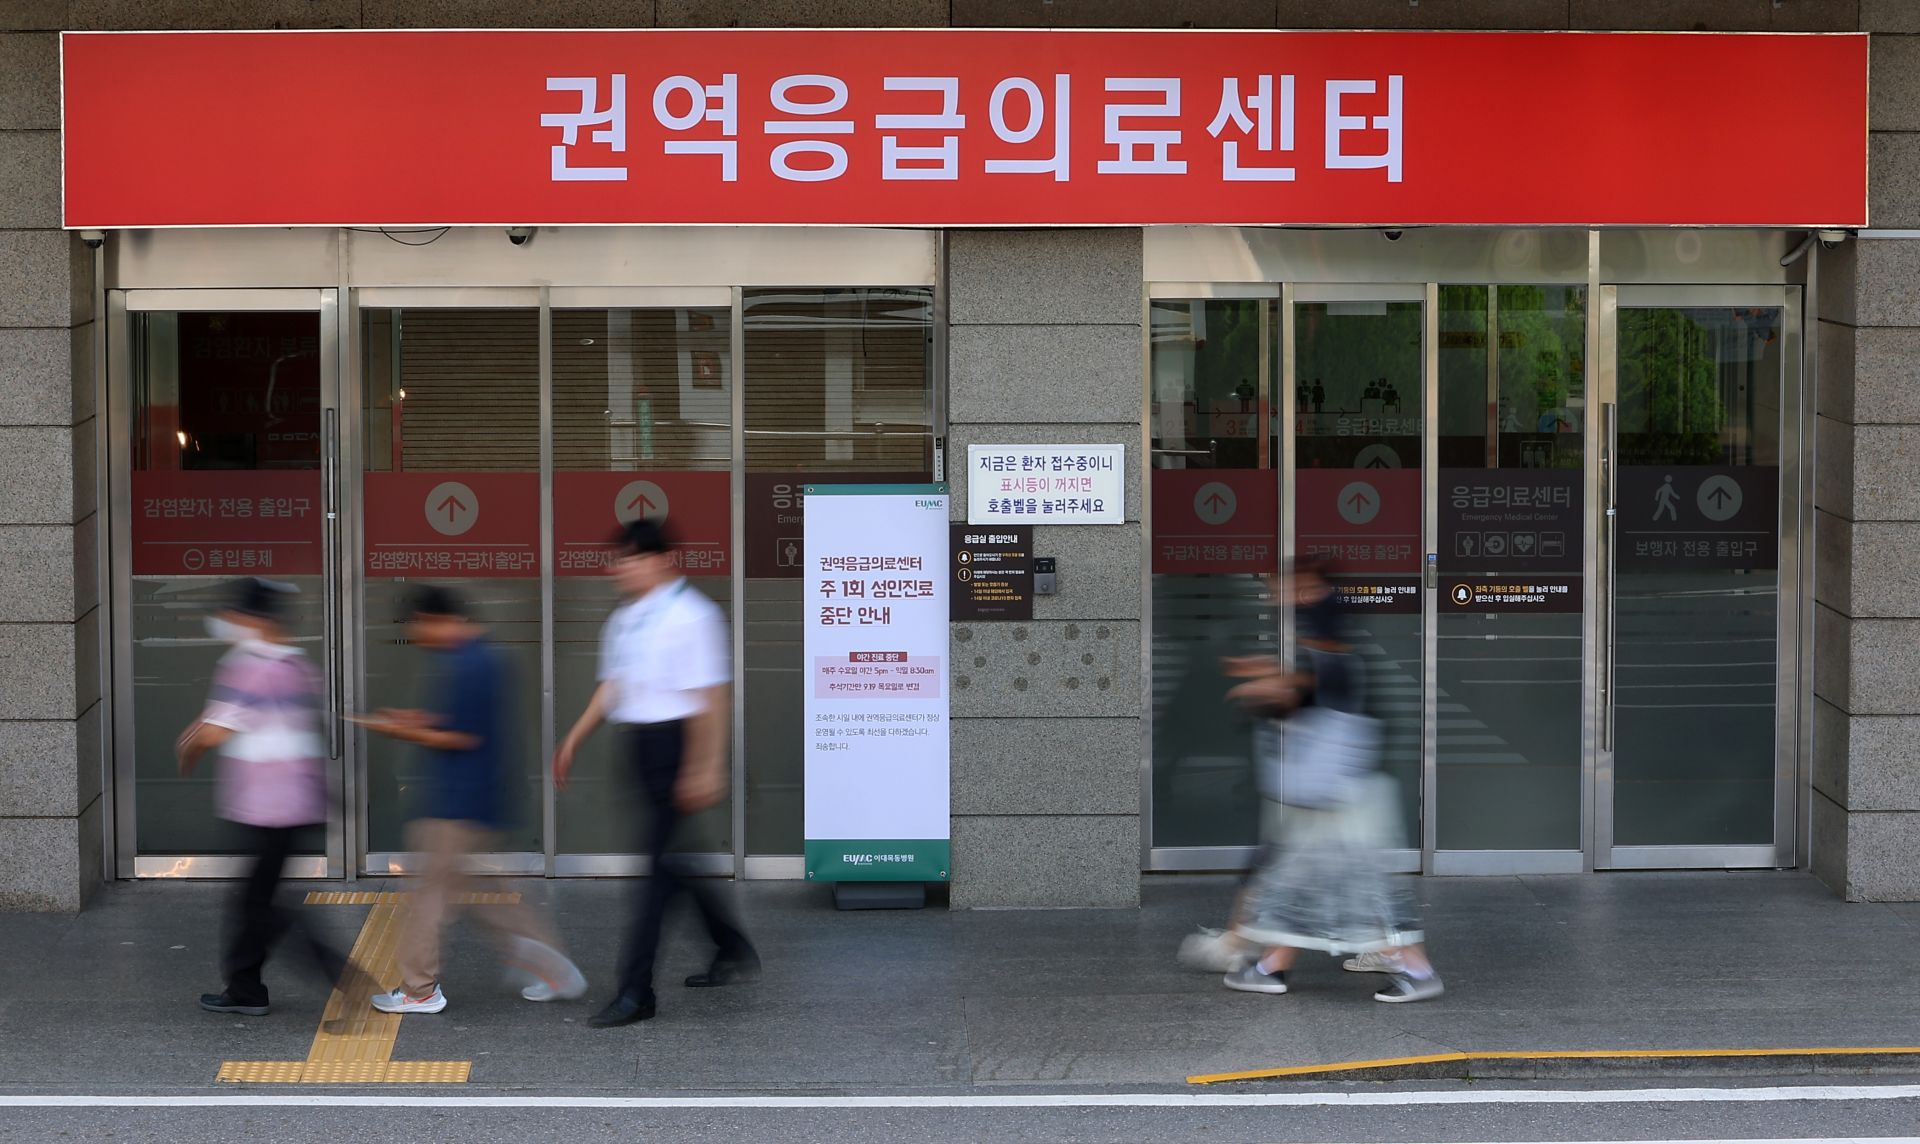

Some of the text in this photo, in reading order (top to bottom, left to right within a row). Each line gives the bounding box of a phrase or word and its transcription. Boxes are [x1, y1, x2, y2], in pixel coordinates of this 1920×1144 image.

[540, 73, 1404, 183] 권역응급의료센터
[980, 456, 1113, 471] 지금은 환자 접수중이니
[1001, 477, 1092, 493] 표시등이 꺼지면
[1451, 486, 1570, 508] 응급의료센터
[143, 498, 312, 518] 감염환자 전용 출입구
[988, 498, 1105, 514] 호출벨을 눌러주세요
[1462, 513, 1502, 522] Emergency
[964, 535, 1018, 544] 응급실 출입안내
[1162, 545, 1269, 560] 구급차 전용 출입구
[1345, 545, 1373, 560] 전용
[1375, 545, 1412, 560] 출입구
[1635, 541, 1758, 557] 보행자 전용 출입구
[209, 549, 273, 568] 출입통제
[369, 552, 536, 570] 감염환자 전용 구급차 출입구
[559, 551, 611, 569] 감염환자
[685, 551, 725, 569] 출입구
[820, 556, 922, 572] 권역응급의료센터
[820, 580, 934, 598] 주 1회 성인진료
[1357, 586, 1369, 594] 호출
[1370, 586, 1383, 594] 벨을
[1384, 586, 1397, 594] 눌러
[1398, 586, 1417, 594] 안내를
[1475, 585, 1568, 593] 좌측 기둥의 호출 벨을 눌러 안내를
[1344, 596, 1350, 604] 후
[1351, 596, 1394, 604] 입실해주십시오
[1475, 595, 1546, 603] 받으신 후 입실해주십시오
[820, 606, 890, 625] 중단 안내
[857, 653, 899, 662] 야간 진료 중단
[822, 667, 836, 675] 매주
[838, 667, 857, 675] 수요일
[859, 667, 873, 675] 야간
[874, 667, 888, 676] 5pm
[895, 667, 908, 675] 익일
[829, 683, 861, 691] 추석기간만
[878, 683, 904, 691] 목요일로
[906, 683, 920, 691] 변경
[816, 713, 940, 722] 조속한 시일 내에 권역응급의료센터가 정상
